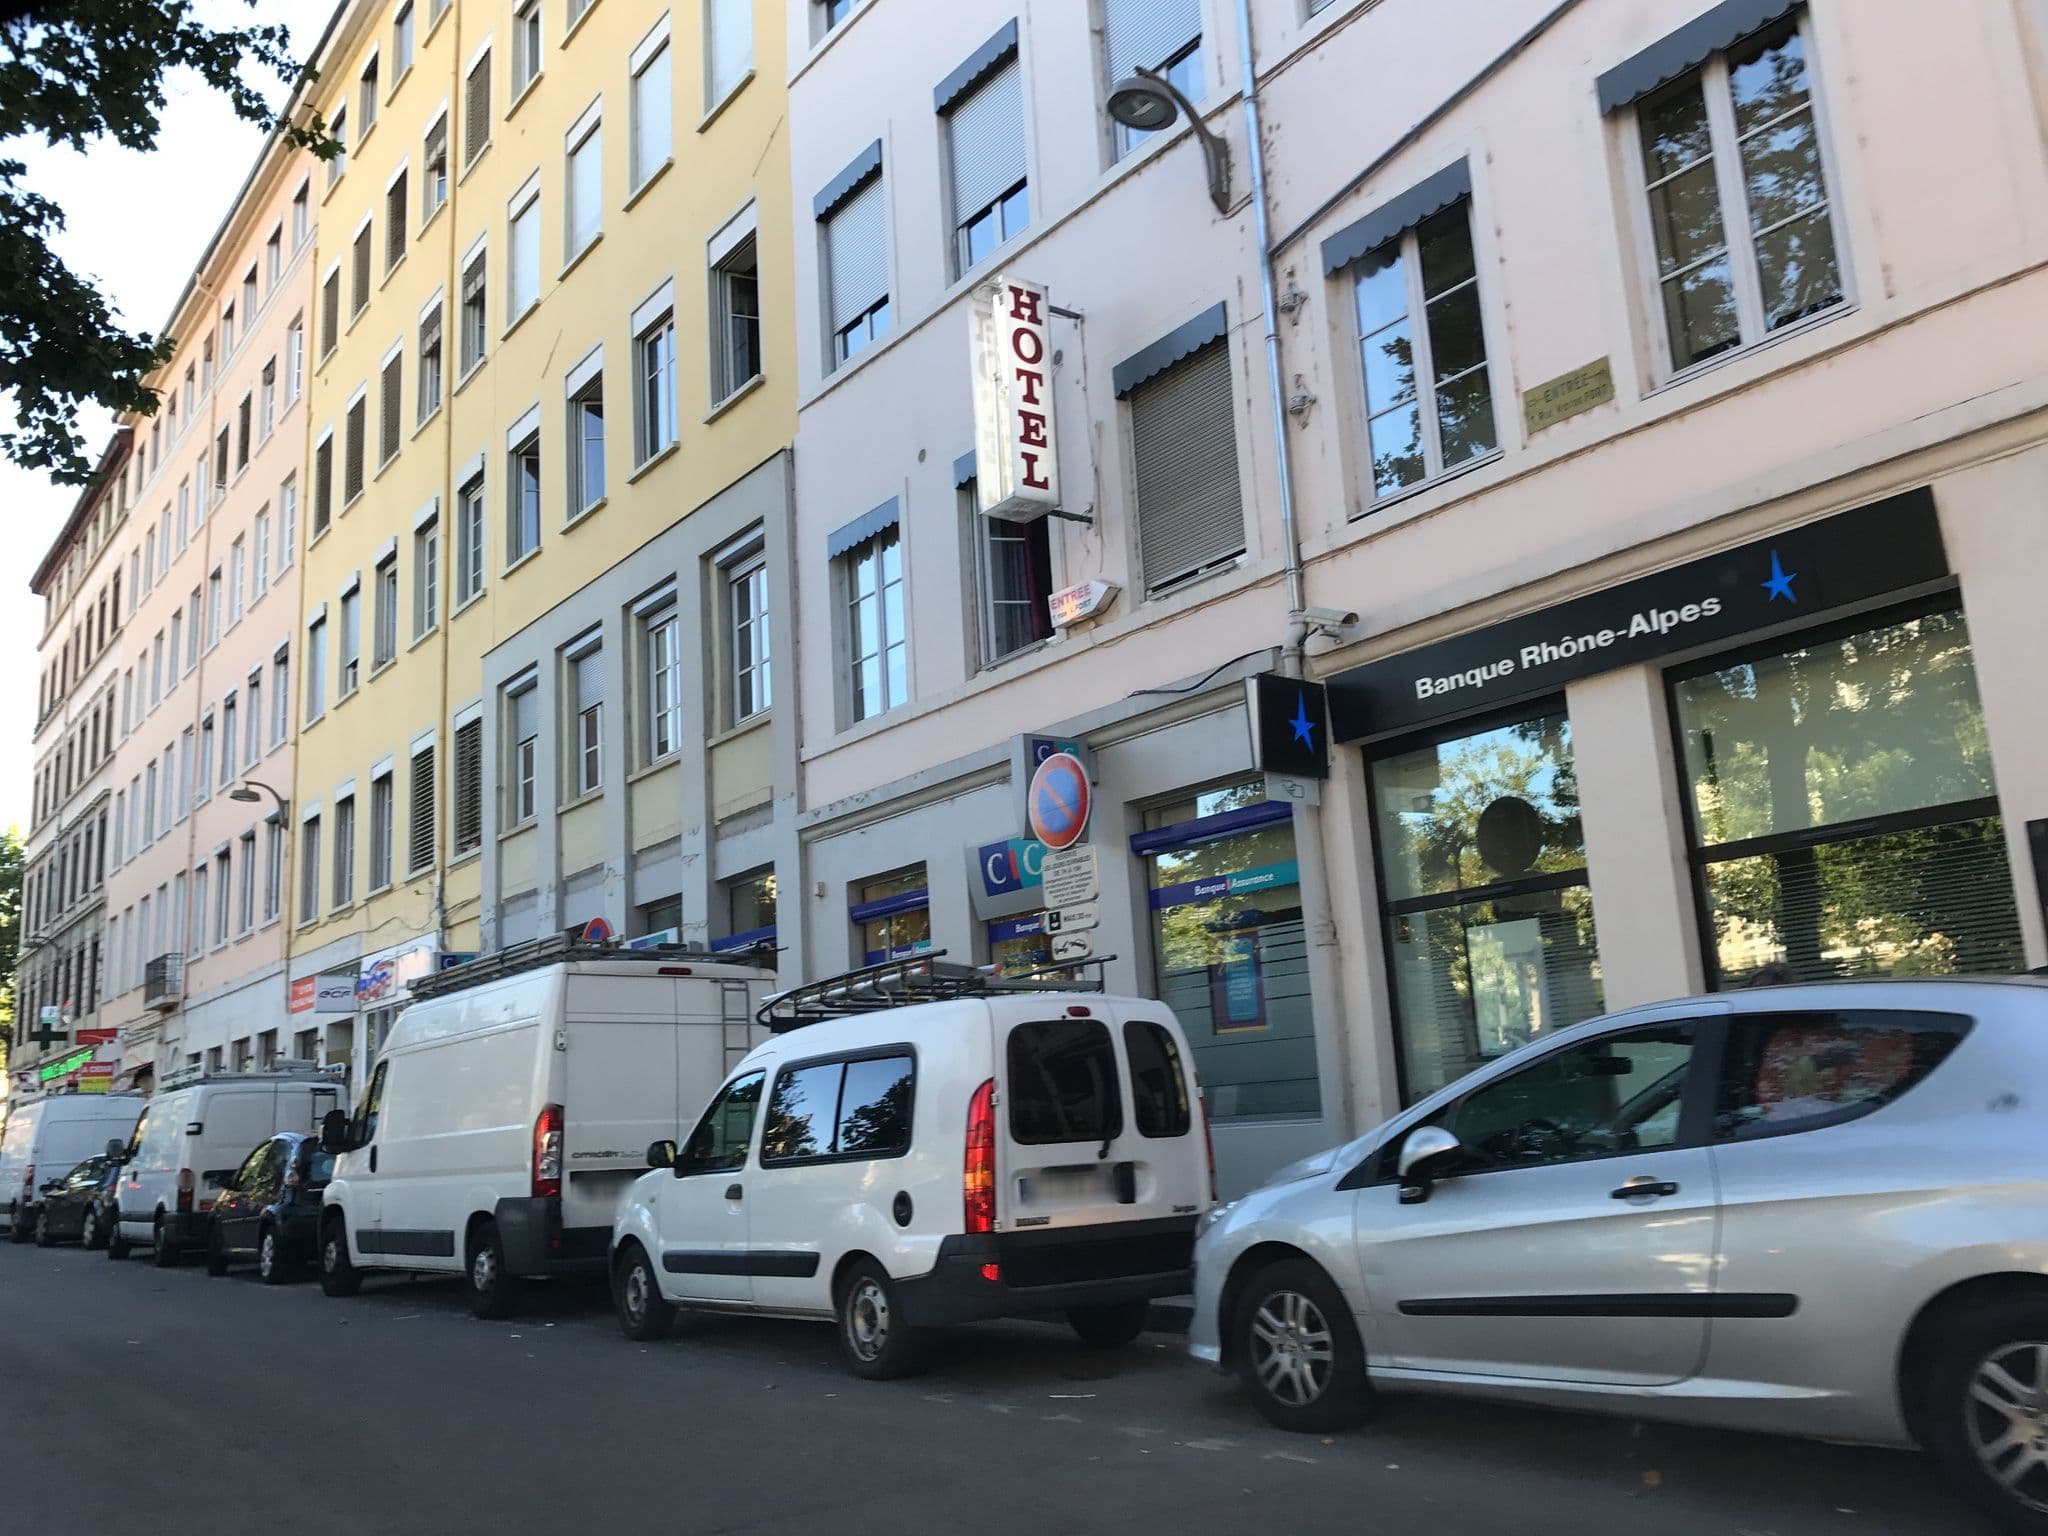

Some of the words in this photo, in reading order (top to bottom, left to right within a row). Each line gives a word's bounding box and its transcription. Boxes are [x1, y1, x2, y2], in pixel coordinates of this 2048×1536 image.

[1008, 285, 1049, 490] HOTEL
[1415, 659, 1515, 699] Banque
[1519, 597, 1722, 669] Rhône-Alpes
[987, 843, 1042, 885] CIC
[1194, 883, 1226, 896] Banque
[1231, 872, 1274, 889] Assurance
[1015, 920, 1040, 934] Banque
